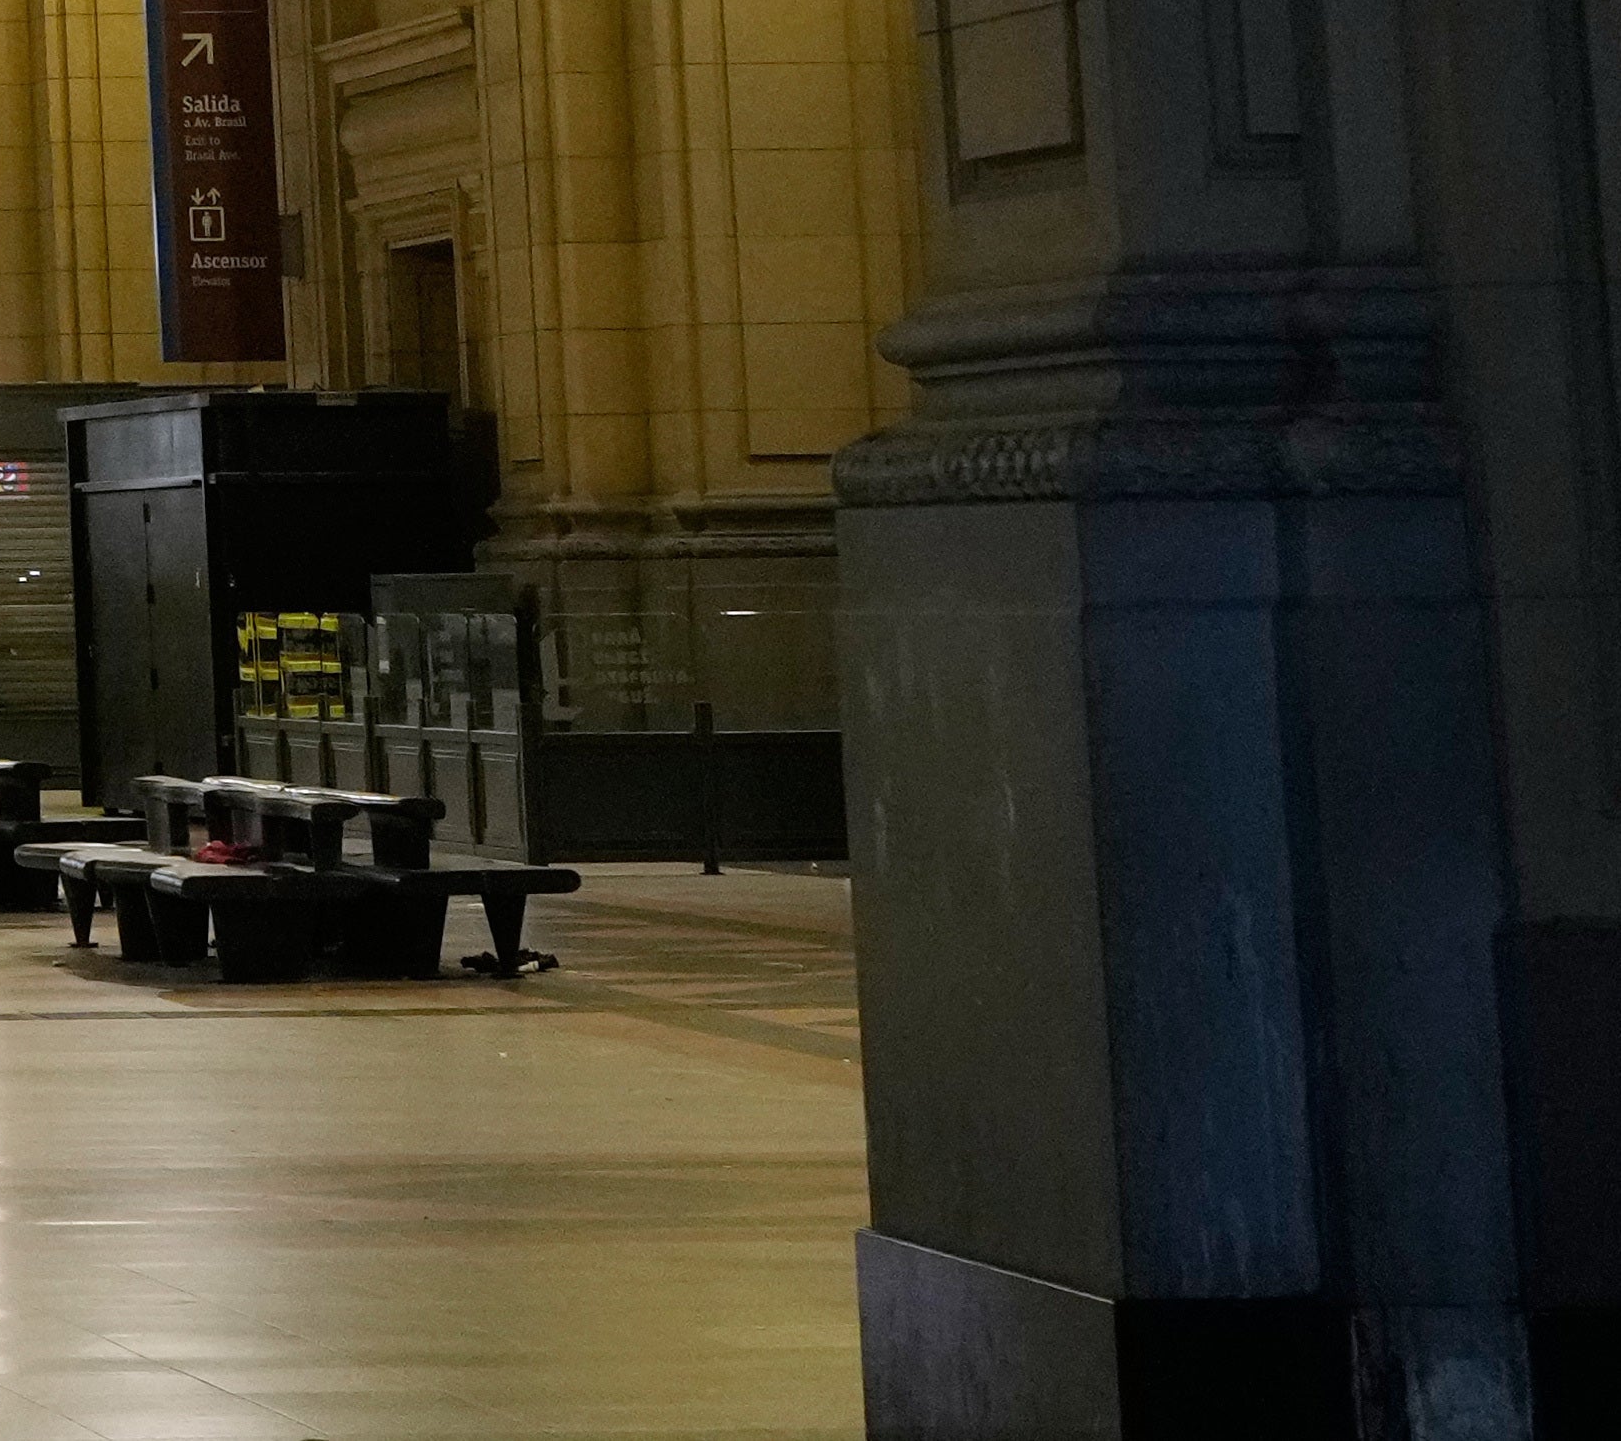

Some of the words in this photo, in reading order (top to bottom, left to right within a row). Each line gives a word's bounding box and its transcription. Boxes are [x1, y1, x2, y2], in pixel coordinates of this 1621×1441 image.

[182, 94, 241, 113] Salida
[184, 119, 192, 128] a
[194, 117, 212, 128] Av.
[215, 116, 247, 127] Brasil
[209, 135, 220, 146] to
[191, 252, 268, 269] Ascensor
